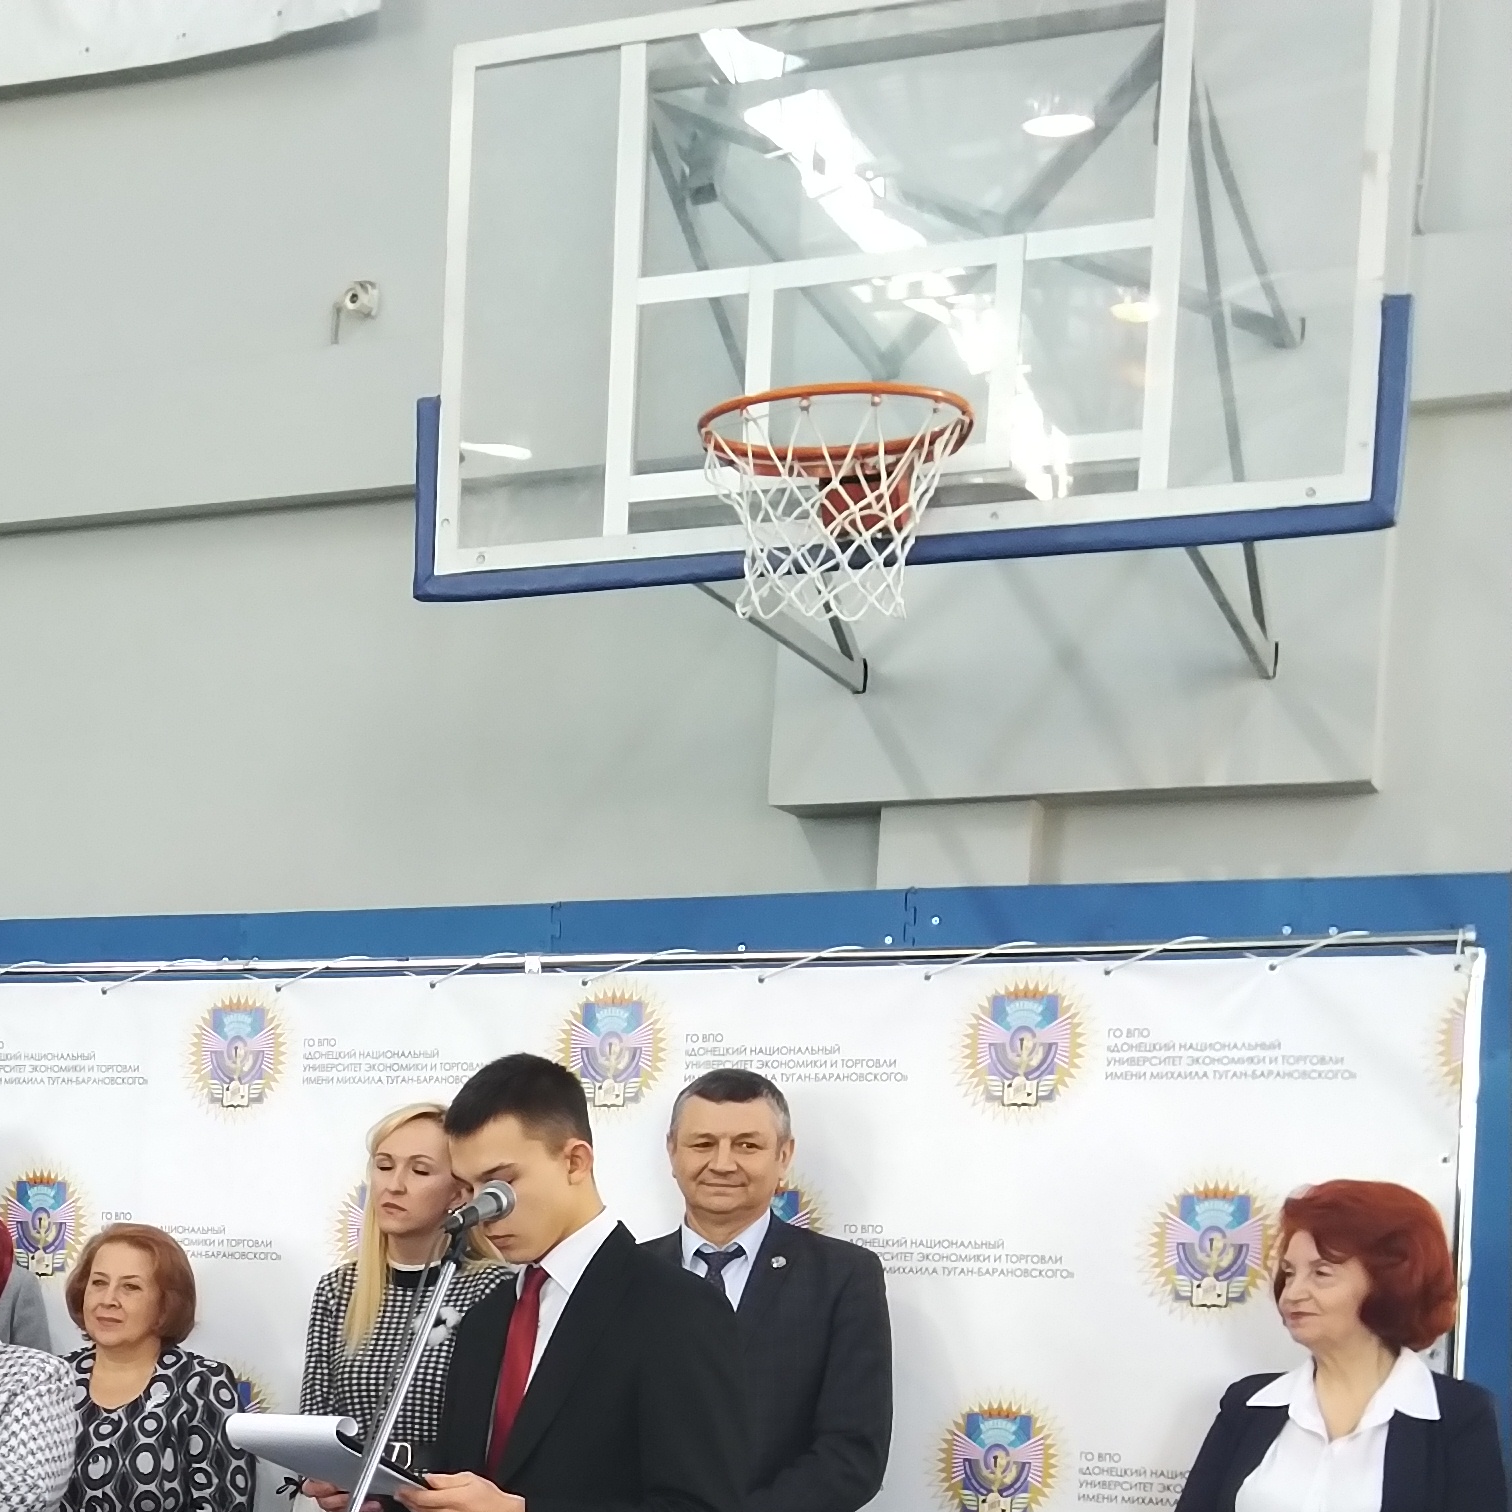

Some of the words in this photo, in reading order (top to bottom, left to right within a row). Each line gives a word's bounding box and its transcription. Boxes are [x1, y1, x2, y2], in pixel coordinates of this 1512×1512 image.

[685, 1033, 699, 1043] ГО
[702, 1033, 724, 1043] ВПО
[1107, 1028, 1123, 1039] ГО
[1126, 1028, 1151, 1039] ВПО
[303, 1038, 316, 1047] ГО
[317, 1038, 337, 1047] ВПО
[749, 1043, 841, 1056] НАЦИОНАЛЬНЫЙ
[756, 1059, 828, 1070] ЭКОНОМИКИ
[830, 1059, 838, 1069] И
[841, 1058, 897, 1069] ТОРГОВЛИ
[1106, 1056, 1183, 1067] УНИВЕРСИТЕТ
[1186, 1055, 1266, 1067] ЭКОНОМИКИ
[1269, 1055, 1278, 1066] И
[28, 1065, 86, 1073] ЭКОНОМИКИ
[87, 1065, 95, 1073] И
[302, 1063, 363, 1073] УНИВЕРСИТЕТ
[364, 1063, 428, 1073] ЭКОНОМИКИ
[430, 1063, 437, 1072] И
[3, 1077, 45, 1085] МИХАИЛА
[302, 1076, 334, 1085] ИМЕНИ
[336, 1076, 384, 1085] МИХАИЛА
[1105, 1070, 1147, 1081] ИМЕНИ
[1150, 1070, 1209, 1081] МИХАИЛА
[101, 1211, 113, 1220] ГО
[114, 1211, 133, 1221] ВПО
[843, 1224, 858, 1234] ГО
[860, 1224, 884, 1234] ВПО
[226, 1239, 273, 1249] ТОРГОВЛИ
[910, 1238, 1005, 1250] НАЦИОНАЛЬНЫЙ
[916, 1252, 991, 1264] ЭКОНОМИКИ
[993, 1254, 1002, 1264] И
[1005, 1254, 1063, 1265] ТОРГОВЛИ
[1079, 1451, 1094, 1462] ГО
[1097, 1452, 1122, 1463] ВПО
[1078, 1479, 1154, 1493] УНИВЕРСИТЕТ
[1077, 1493, 1118, 1505] ИМЕНИ
